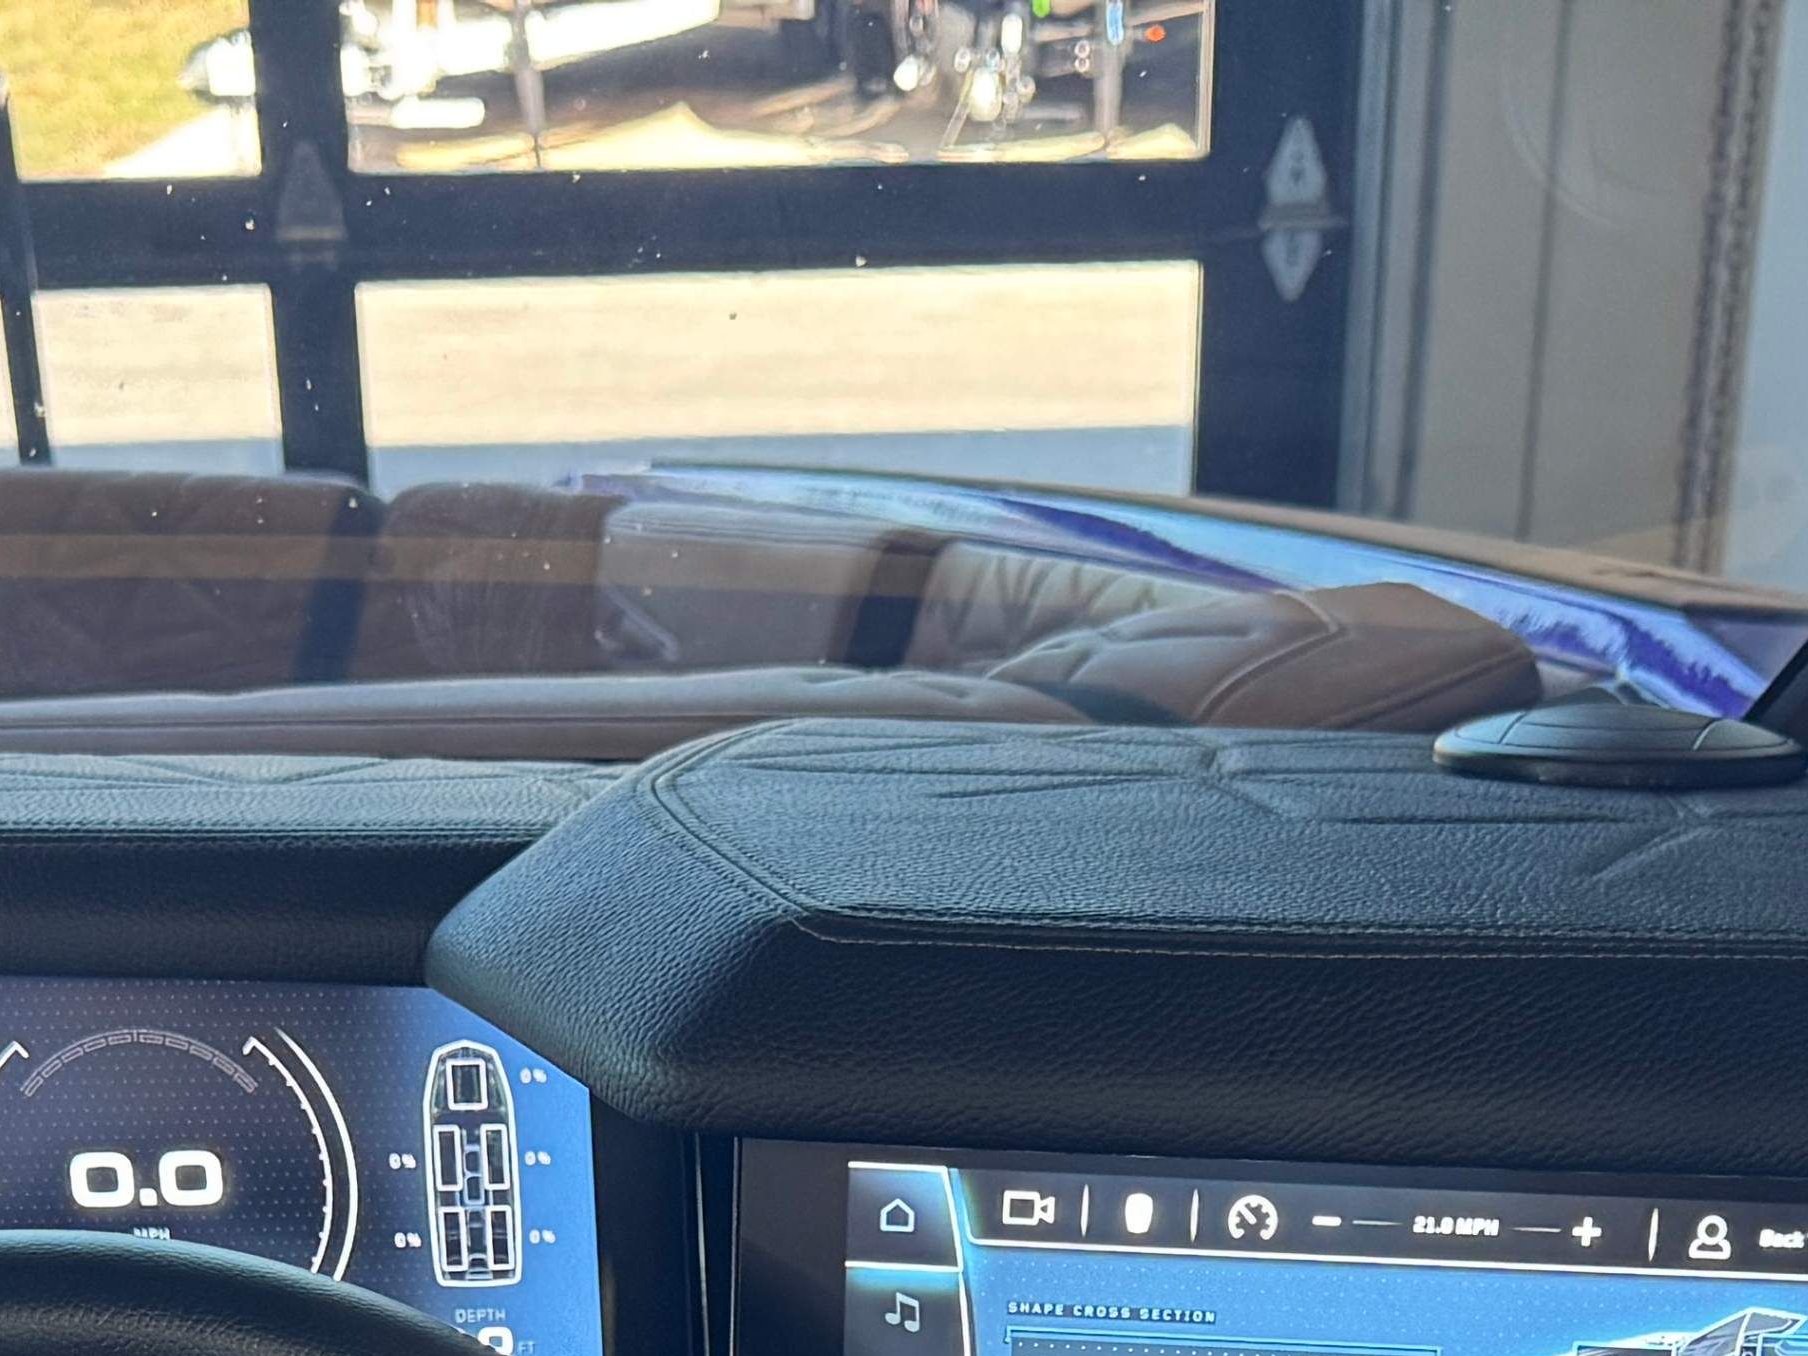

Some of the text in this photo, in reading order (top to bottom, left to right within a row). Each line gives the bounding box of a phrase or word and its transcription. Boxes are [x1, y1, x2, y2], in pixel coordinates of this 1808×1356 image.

[69, 1150, 224, 1208] 0.0
[455, 1309, 506, 1323] DEPTH
[1008, 1302, 1215, 1323] SHAPE CROSS SECTION
